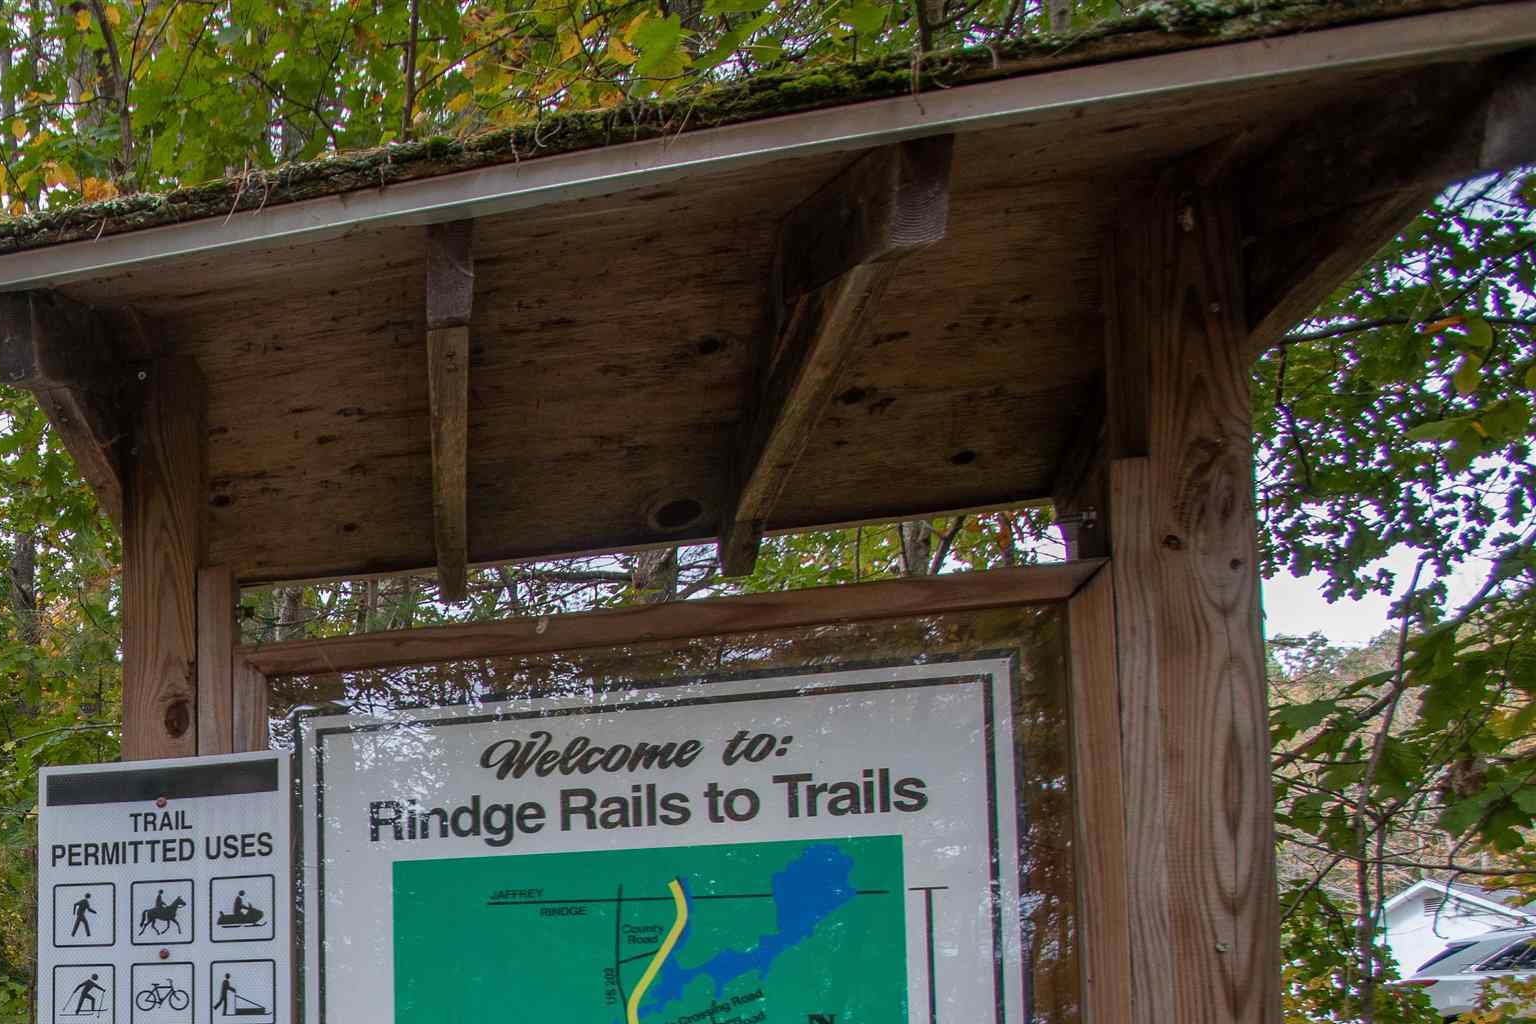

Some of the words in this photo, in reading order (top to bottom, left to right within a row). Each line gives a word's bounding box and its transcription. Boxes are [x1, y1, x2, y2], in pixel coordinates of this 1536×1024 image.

[480, 731, 704, 780] Welcome
[722, 730, 794, 766] to:
[369, 795, 546, 847] Rindge
[560, 783, 691, 831] Rails
[704, 783, 760, 823] to
[772, 768, 929, 818] Trails
[129, 811, 192, 832] TRAIL
[52, 838, 195, 867] PERMITTED
[205, 832, 273, 860] USES
[490, 888, 544, 900] JAFFREY
[539, 906, 588, 917] RINDGE
[731, 988, 764, 1006] Road
